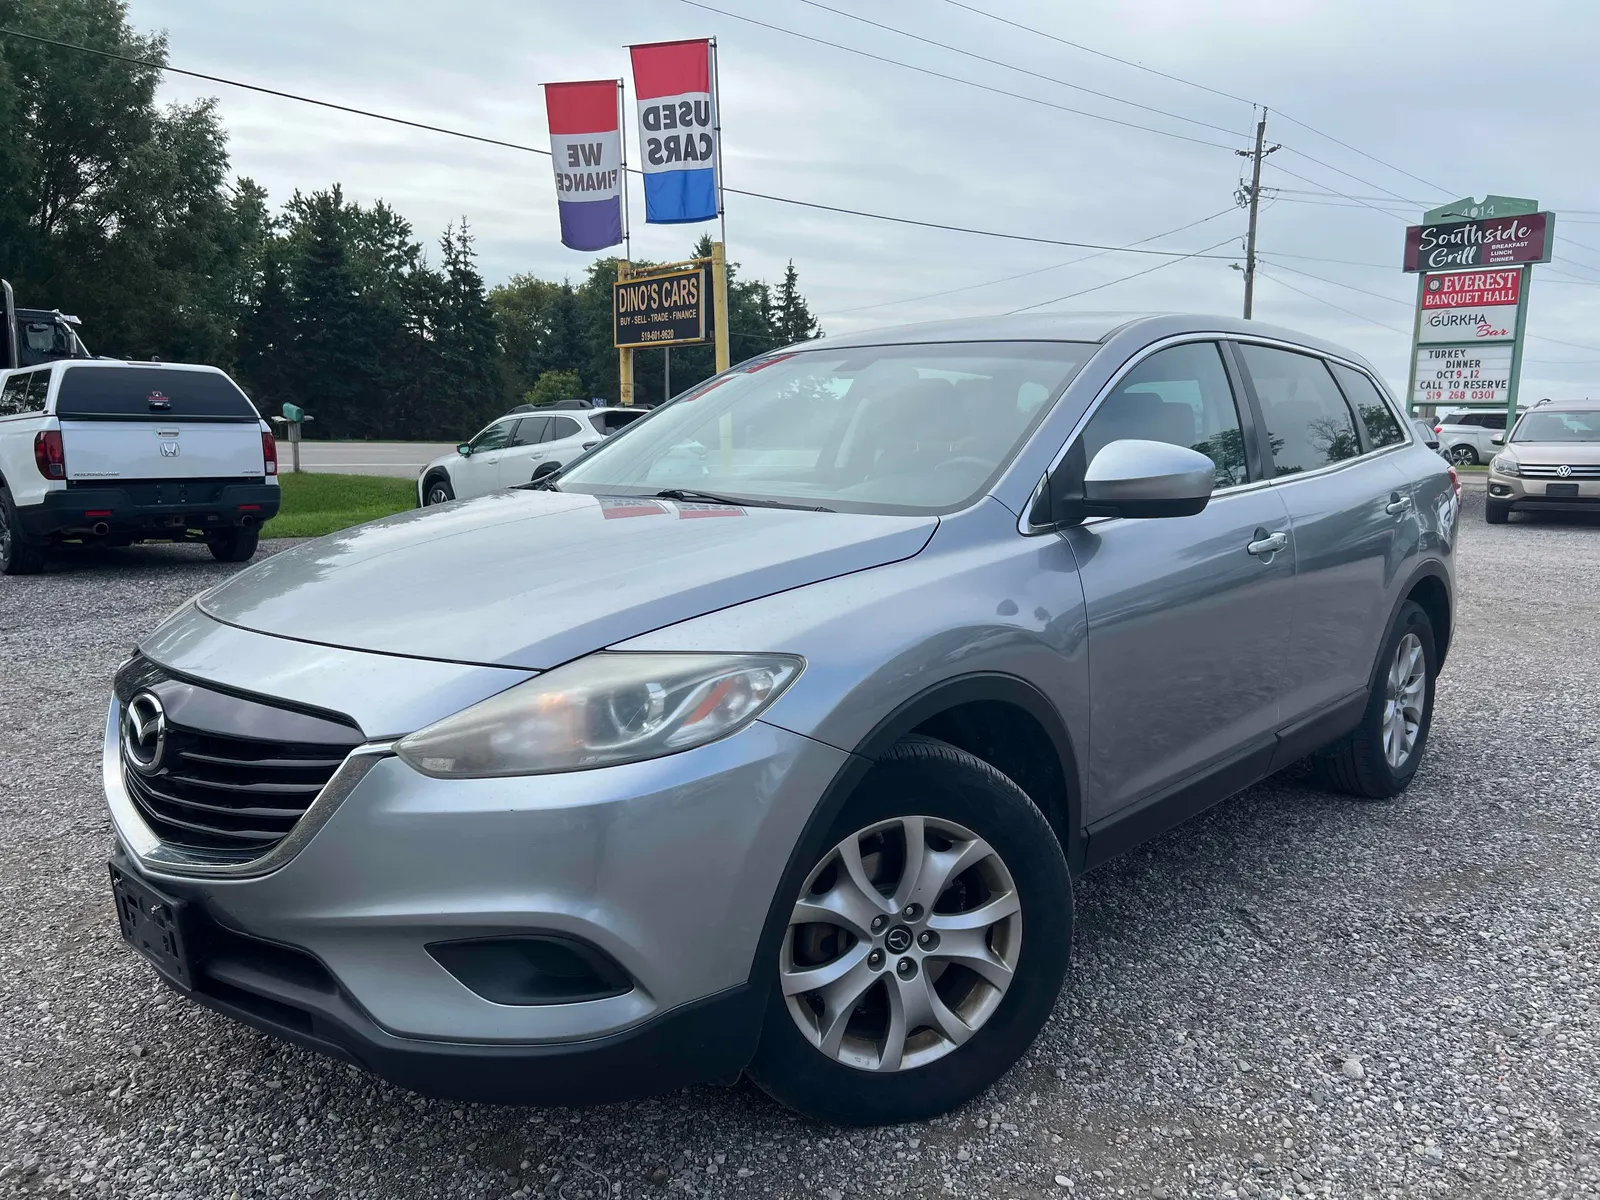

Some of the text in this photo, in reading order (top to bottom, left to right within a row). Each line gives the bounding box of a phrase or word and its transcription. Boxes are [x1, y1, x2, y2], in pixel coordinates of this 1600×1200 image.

[1418, 220, 1531, 250] Southside
[1491, 241, 1529, 250] BREAKFAST
[1428, 246, 1477, 268] Grill
[1443, 271, 1517, 292] EVEREST
[619, 277, 698, 313] DINO'S CARS
[1425, 289, 1515, 307] BANQUET HALL
[620, 316, 631, 326] BUY
[634, 315, 648, 325] SELL
[650, 312, 669, 323] TRADE
[672, 309, 697, 320] FINANCE
[1430, 313, 1488, 327] GURKHA
[1476, 324, 1509, 337] Bar
[1428, 349, 1466, 359] TURKEY
[1445, 359, 1481, 369] DINNER
[1436, 370, 1455, 379] OCT
[1420, 379, 1507, 389] CALL TO RESERVE
[1426, 390, 1495, 400] 519 268 0301
